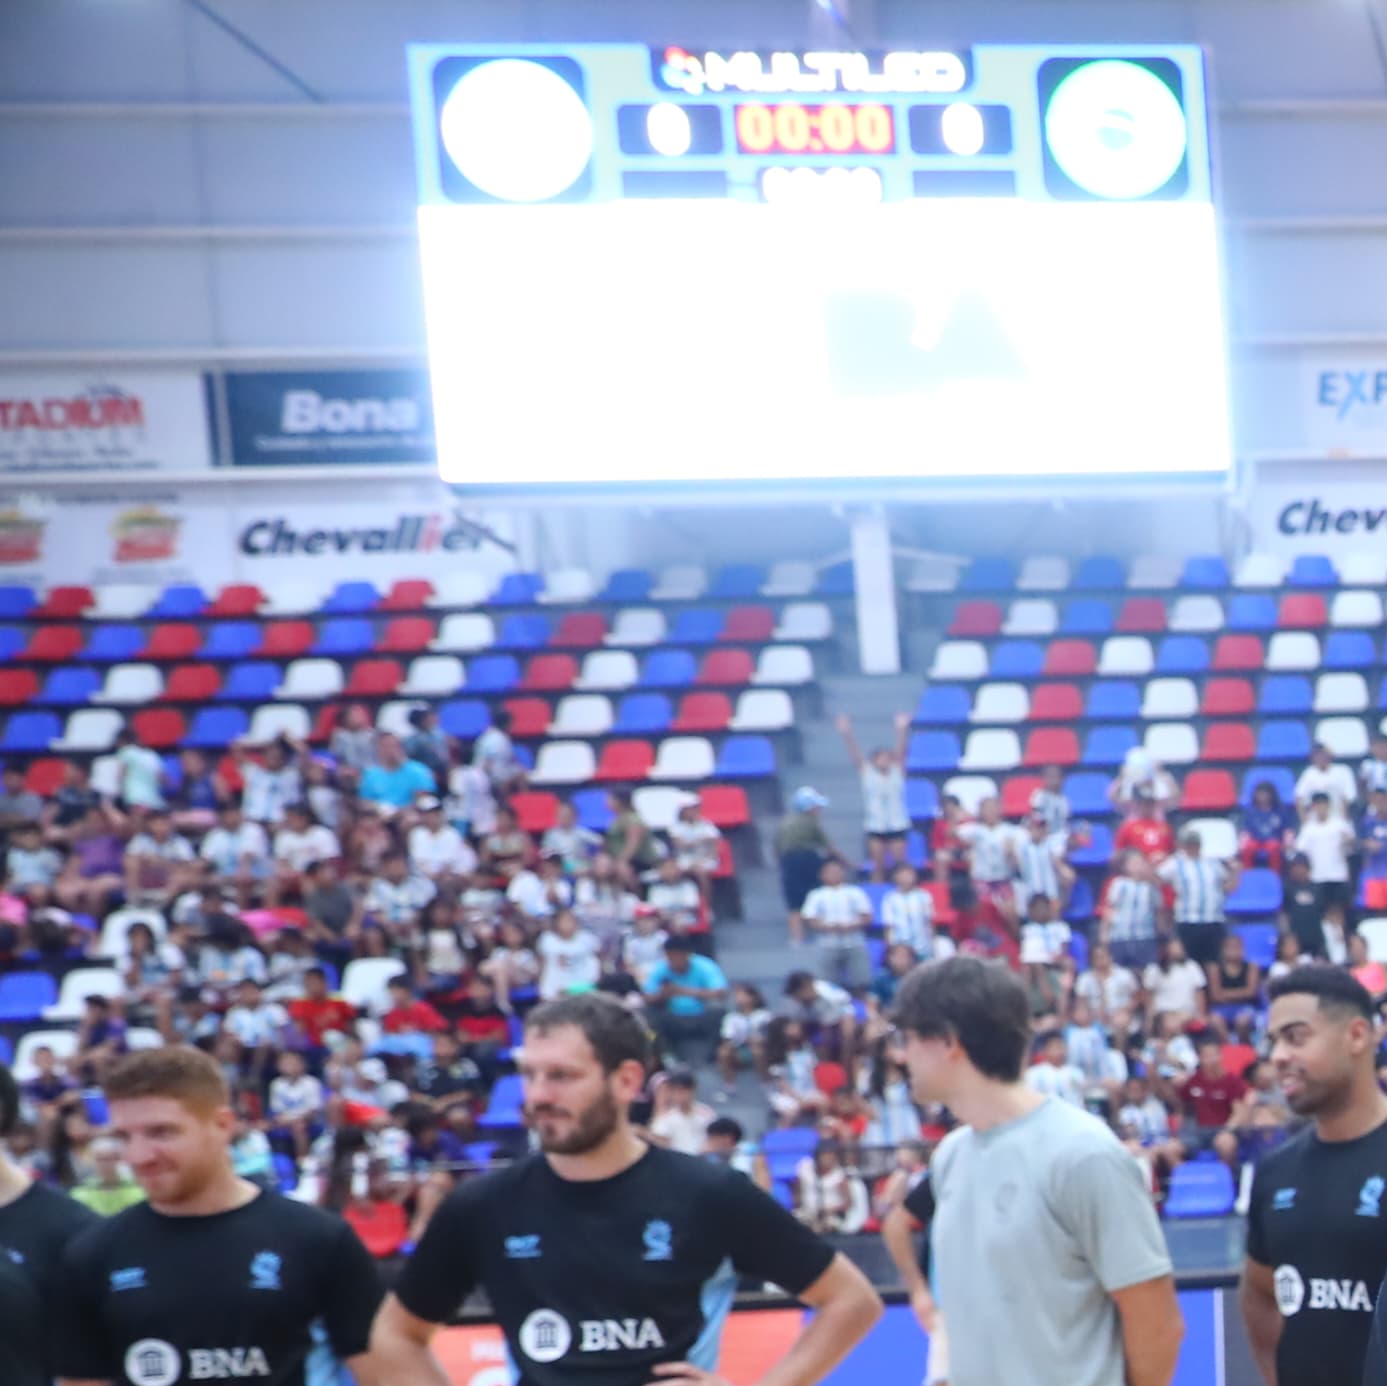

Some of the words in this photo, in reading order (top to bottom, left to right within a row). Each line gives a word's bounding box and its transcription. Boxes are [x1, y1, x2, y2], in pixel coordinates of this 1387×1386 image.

[1309, 1278, 1373, 1312] BNA
[579, 1317, 665, 1351] BNA
[188, 1347, 271, 1379] BNA
